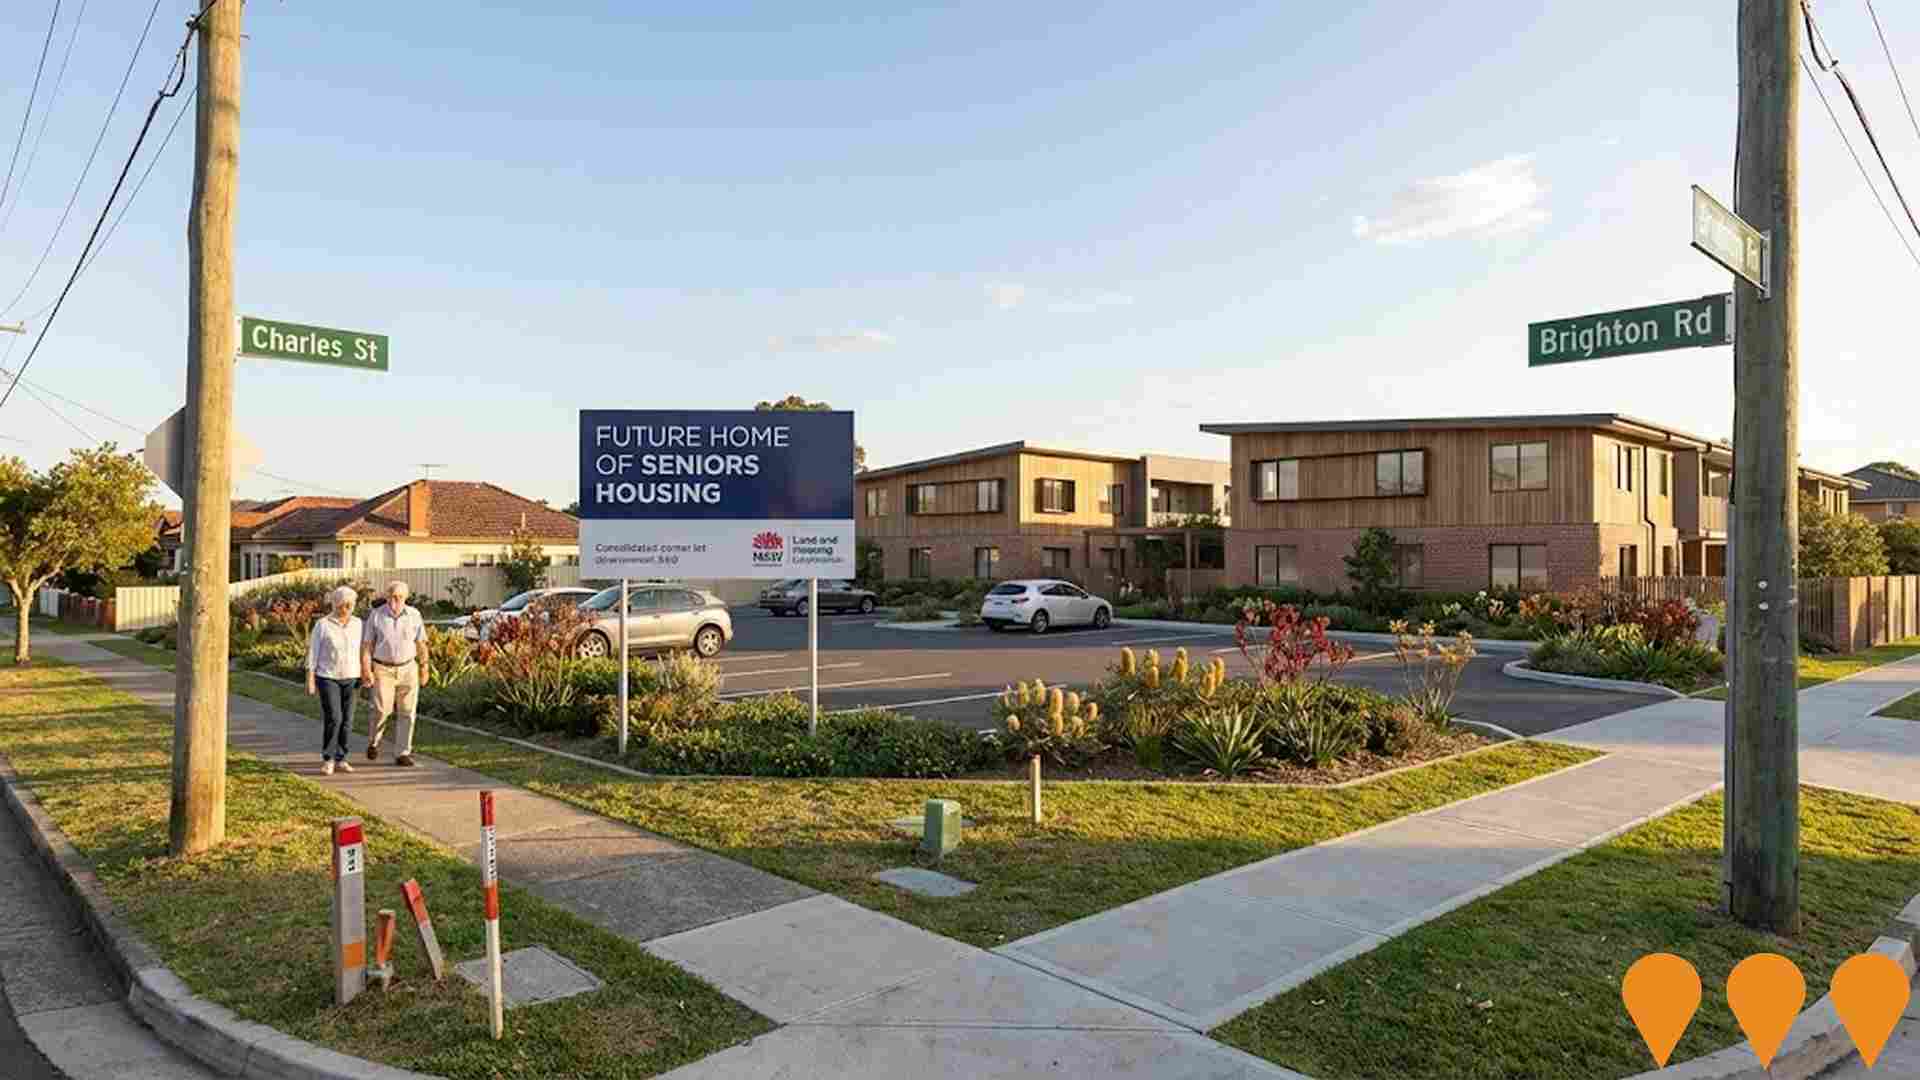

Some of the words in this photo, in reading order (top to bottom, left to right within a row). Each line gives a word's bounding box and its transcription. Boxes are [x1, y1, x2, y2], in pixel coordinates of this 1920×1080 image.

[1540, 320, 1658, 357] Brighton
[1674, 305, 1712, 338] Rd
[252, 325, 343, 357] Charles
[353, 338, 377, 362] St
[596, 426, 701, 447] FUTURE
[710, 426, 790, 447] HOME
[596, 454, 633, 475] OF
[641, 454, 760, 476] SENIORS
[596, 482, 721, 504] HOUSING
